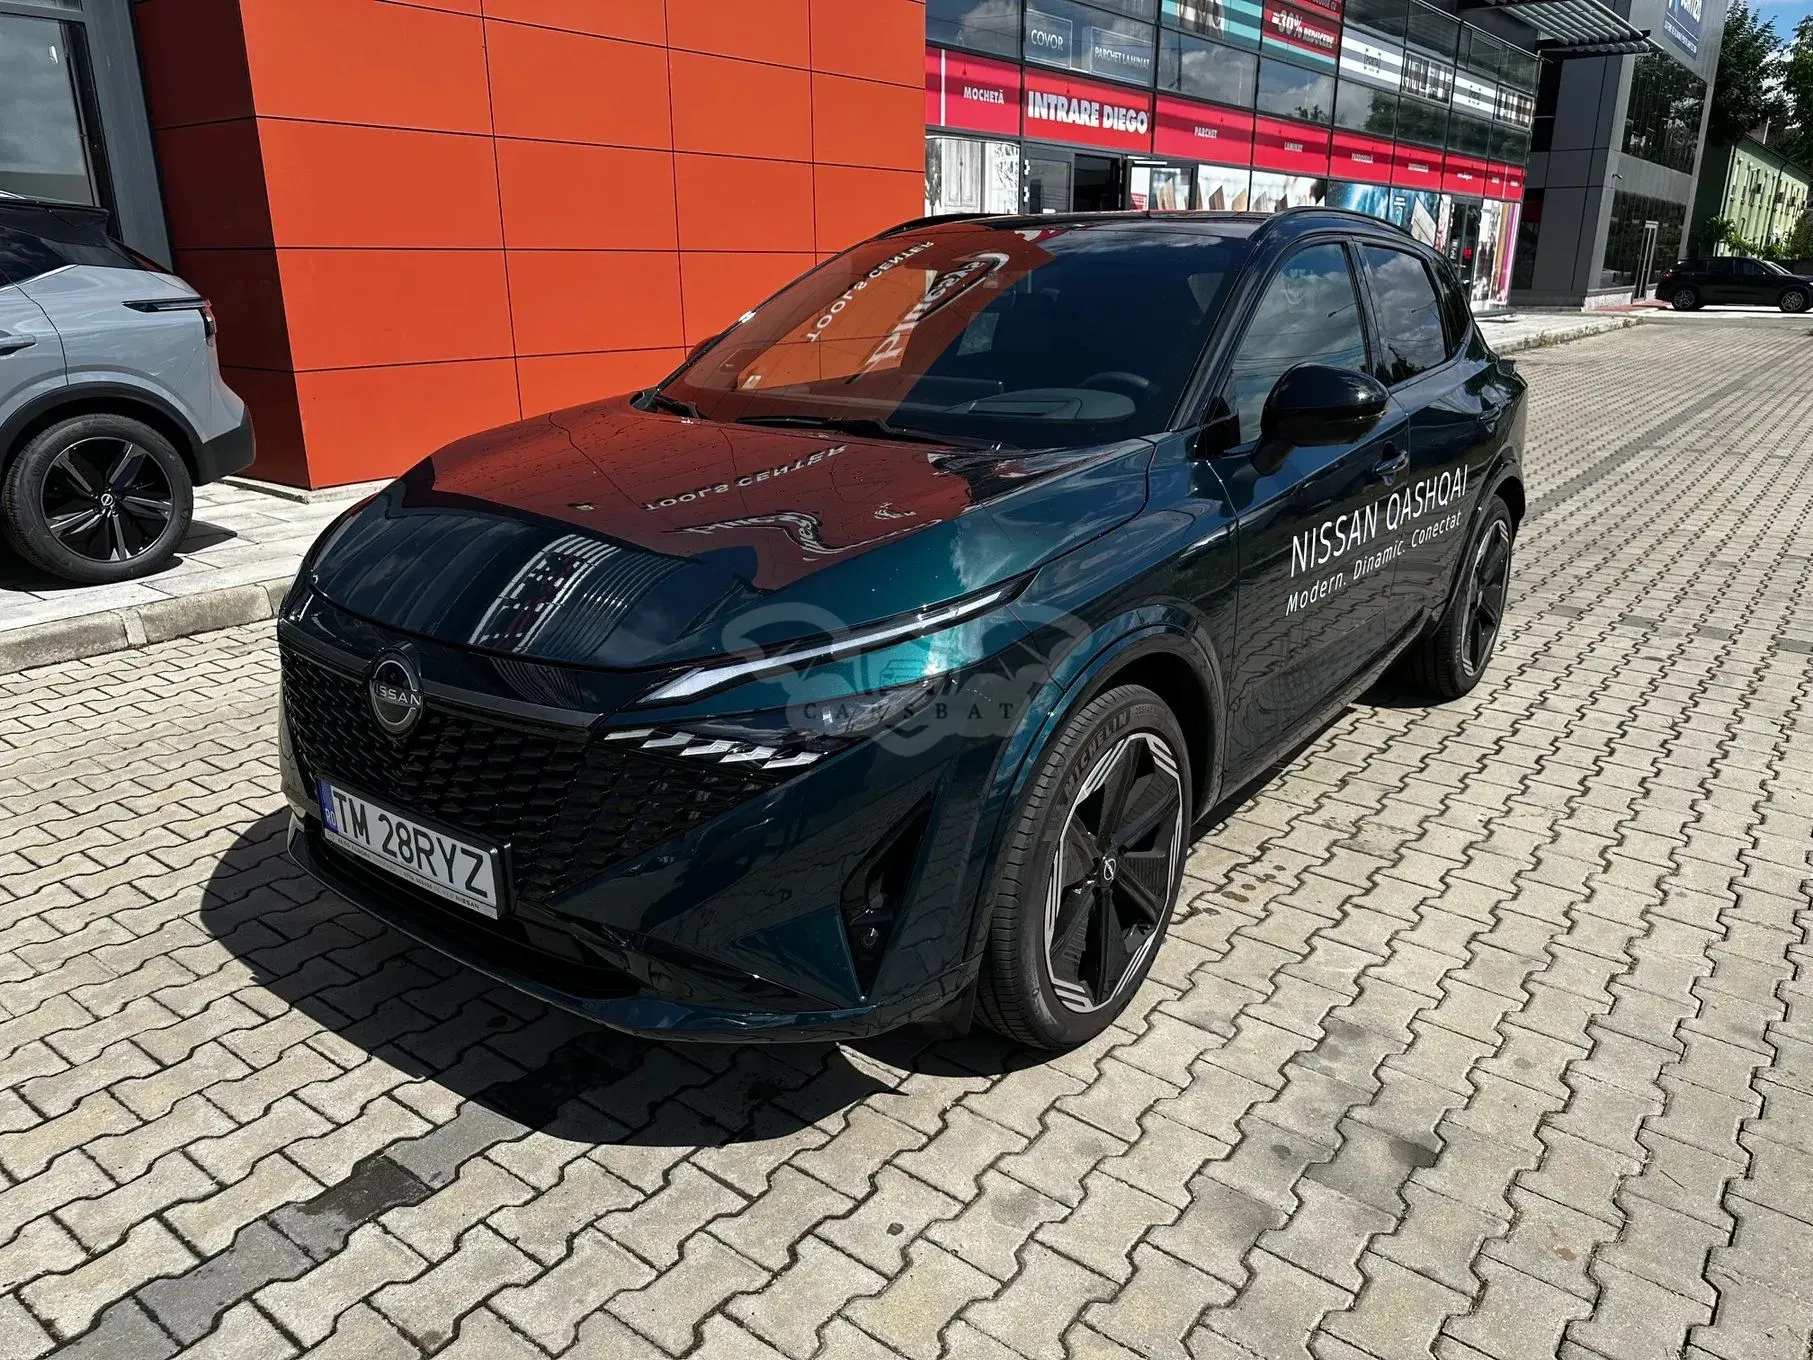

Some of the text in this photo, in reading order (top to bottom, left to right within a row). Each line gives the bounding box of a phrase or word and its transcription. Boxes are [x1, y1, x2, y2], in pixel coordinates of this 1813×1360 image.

[1031, 29, 1064, 50] COVOR
[1095, 46, 1121, 64] PARCHET
[963, 86, 1005, 104] MOCHETĂ
[1027, 91, 1149, 134] INTRARE DIEGO
[1194, 126, 1218, 139] PARCHET
[1290, 464, 1468, 577] NISSAN QASHQAI
[1285, 510, 1461, 616] Modern. Dinamic. Conectat
[1063, 709, 1129, 798] MICHELIN
[325, 808, 337, 826] RO
[332, 791, 488, 898] TM 28RYZ
